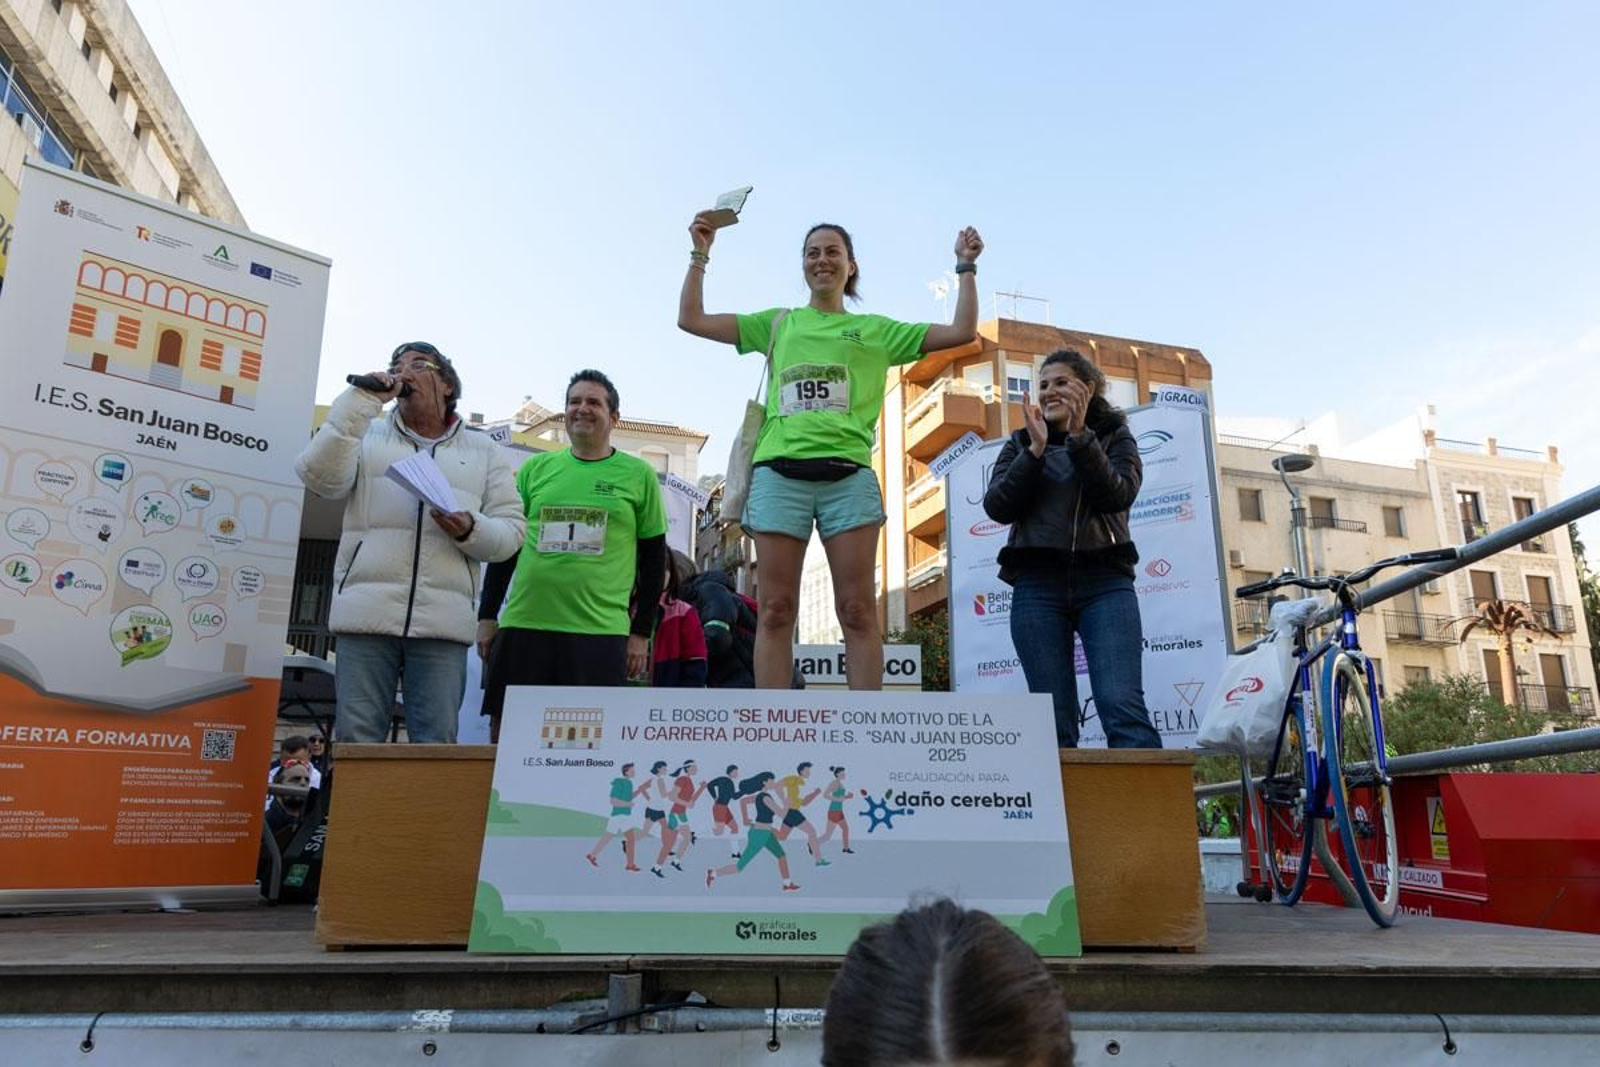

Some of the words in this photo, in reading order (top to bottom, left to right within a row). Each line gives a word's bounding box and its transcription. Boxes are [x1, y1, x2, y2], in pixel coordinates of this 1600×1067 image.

[795, 380, 830, 401] 195
[34, 383, 92, 413] I.E.S.
[97, 398, 144, 424] San
[146, 410, 199, 436] Juan
[203, 422, 269, 452] Bosco
[136, 432, 177, 451] JAÉN
[934, 436, 977, 474] ¡GRACIAS!
[568, 523, 575, 541] 1
[1151, 639, 1203, 652] morales
[650, 708, 667, 722] EL
[672, 708, 729, 723] BOSCO
[841, 711, 876, 725] CON
[881, 712, 944, 725] MOTIVO
[949, 713, 969, 726] DE
[973, 713, 993, 726] LA
[0, 726, 69, 743] FERTA
[75, 730, 192, 749] FORMATIVA
[621, 726, 638, 740] IV
[643, 726, 728, 742] CARRERA
[733, 727, 817, 743] POPULAR
[822, 730, 857, 744] I.E.S.
[910, 731, 956, 745] JUAN
[523, 757, 544, 767] I.E.S.
[545, 758, 564, 767] San
[564, 758, 585, 767] Juan
[585, 758, 614, 767] Bosco
[928, 748, 966, 762] 2025
[889, 771, 975, 783] RECAUDACIÓN
[978, 773, 1010, 783] PARA
[895, 791, 945, 807] daño
[951, 791, 1032, 808] cerebral
[1003, 808, 1032, 819] JAÉN
[1403, 868, 1438, 884] CALZADO
[759, 928, 817, 941] morales
